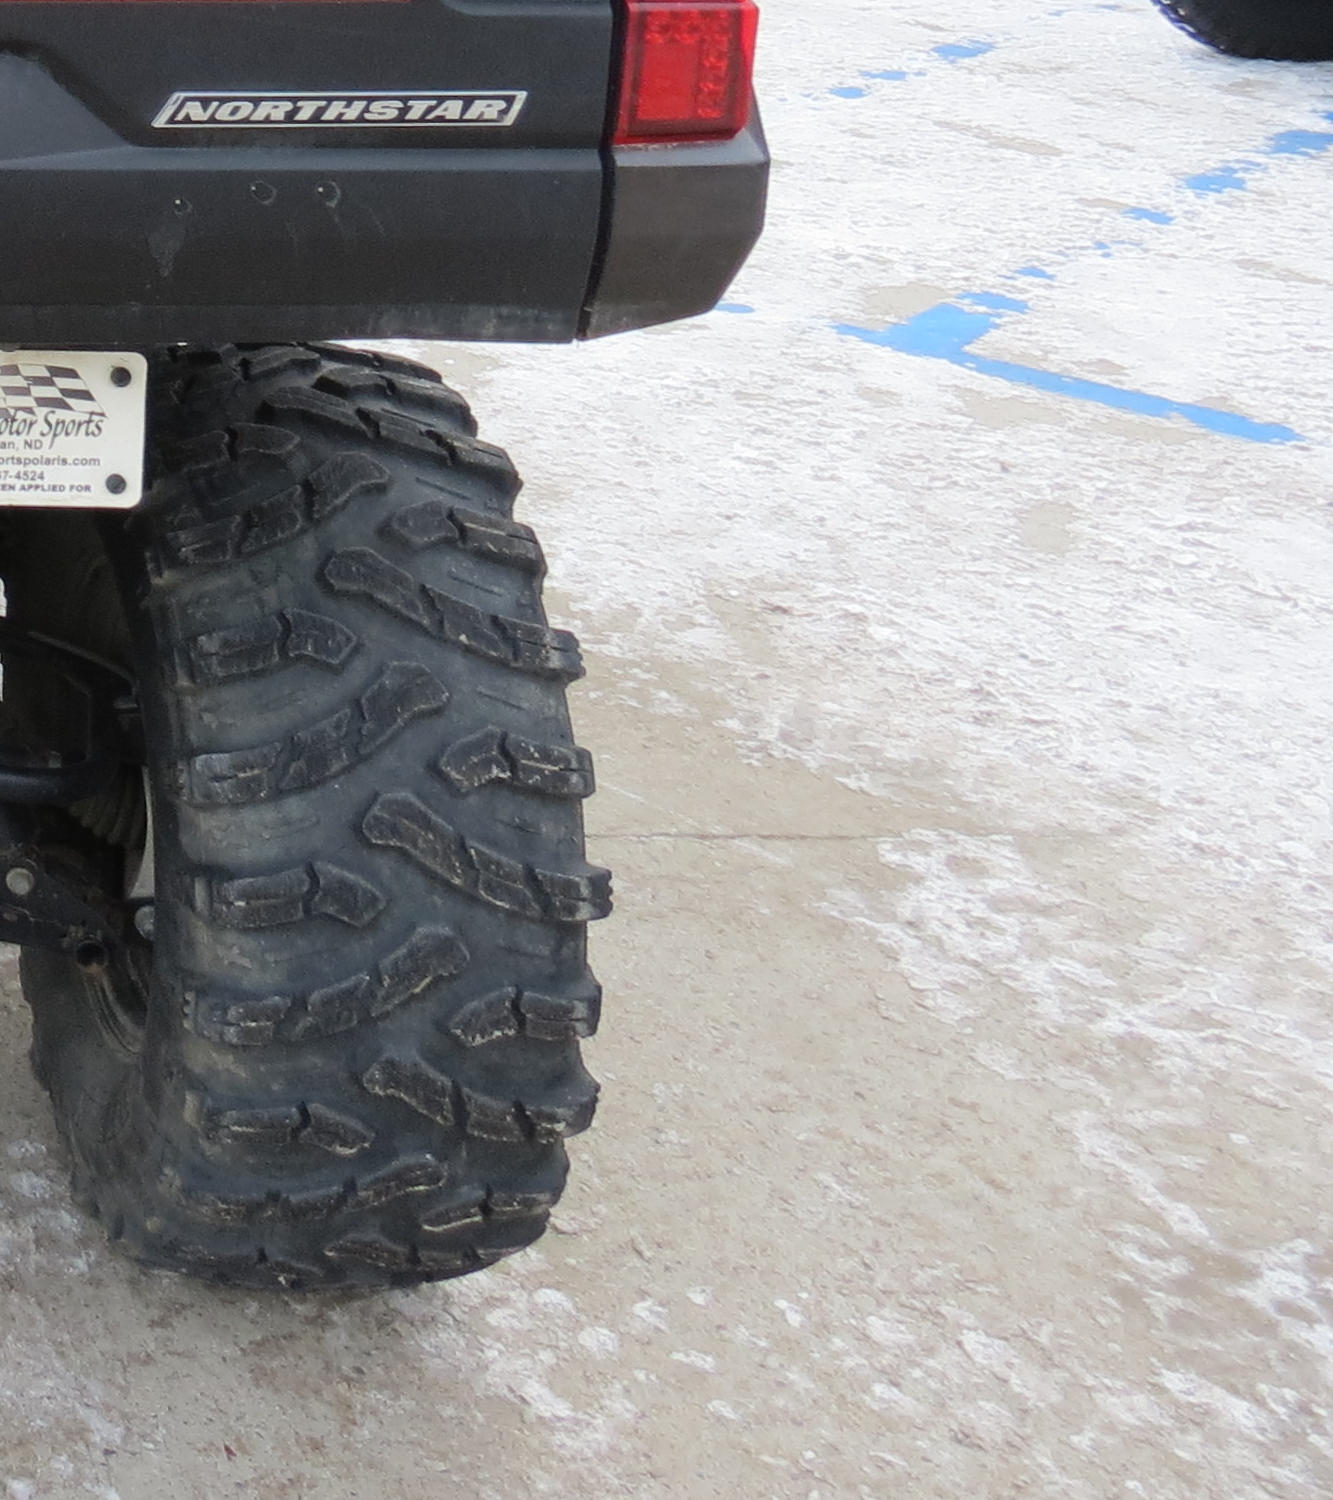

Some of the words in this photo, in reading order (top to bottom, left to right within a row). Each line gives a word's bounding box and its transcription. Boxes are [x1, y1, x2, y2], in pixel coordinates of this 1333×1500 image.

[175, 99, 509, 122] NORTHSTAR
[40, 410, 105, 450] Sports
[23, 438, 44, 450] ND
[18, 483, 66, 493] APPLIED
[69, 484, 92, 493] FOR
